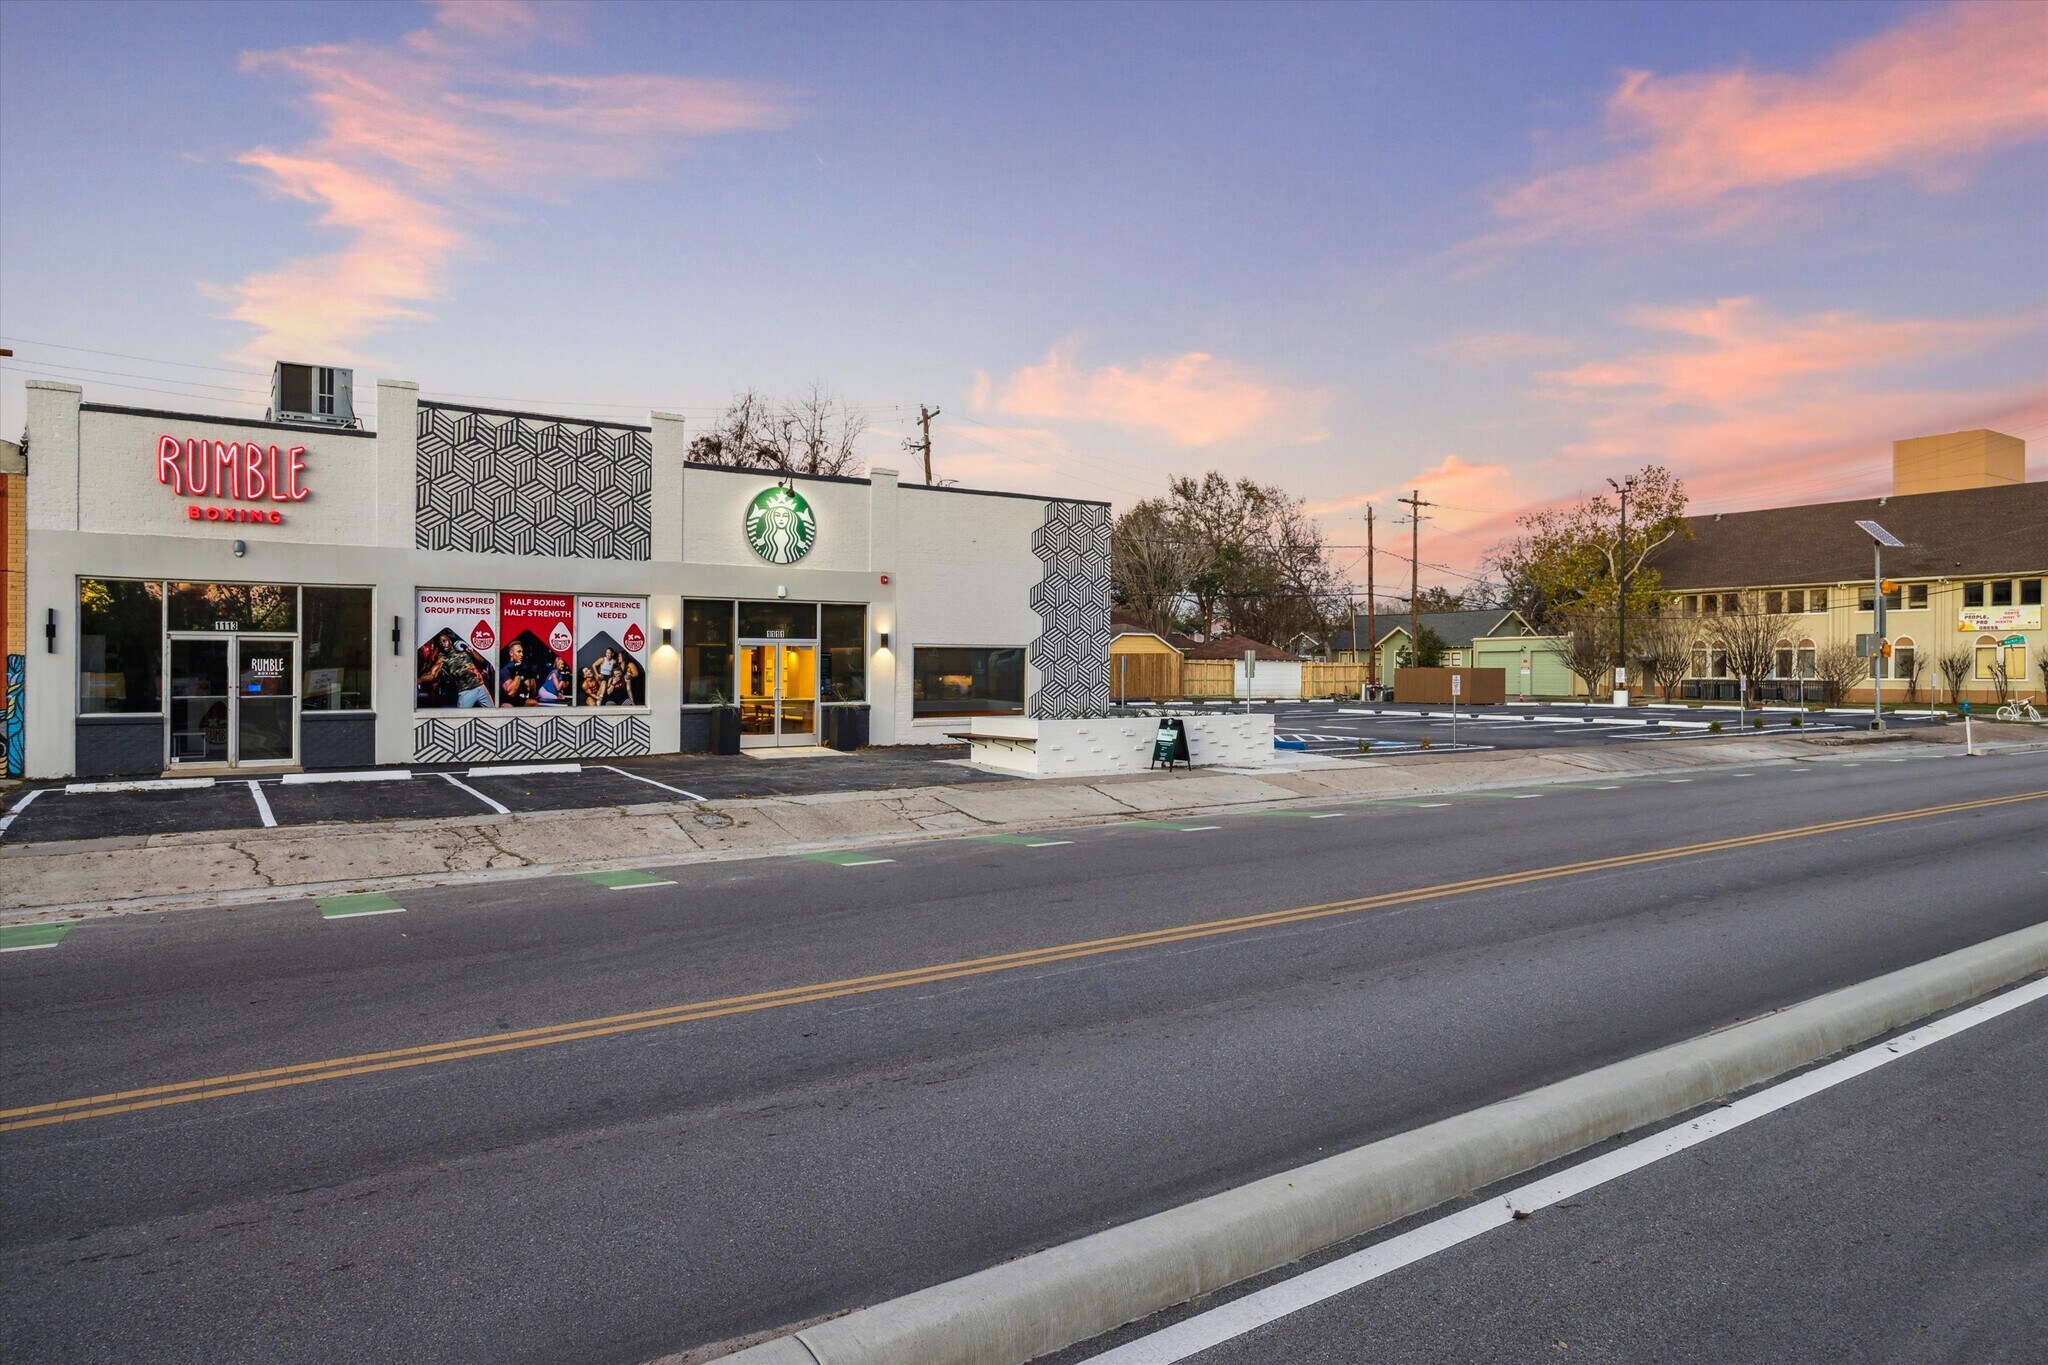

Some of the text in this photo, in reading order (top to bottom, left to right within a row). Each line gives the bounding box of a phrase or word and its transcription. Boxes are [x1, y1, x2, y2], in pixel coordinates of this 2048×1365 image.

[158, 435, 309, 502] RUMBLE
[188, 506, 282, 524] BOXING
[216, 622, 237, 630] 1113
[252, 659, 284, 671] RUMBLE
